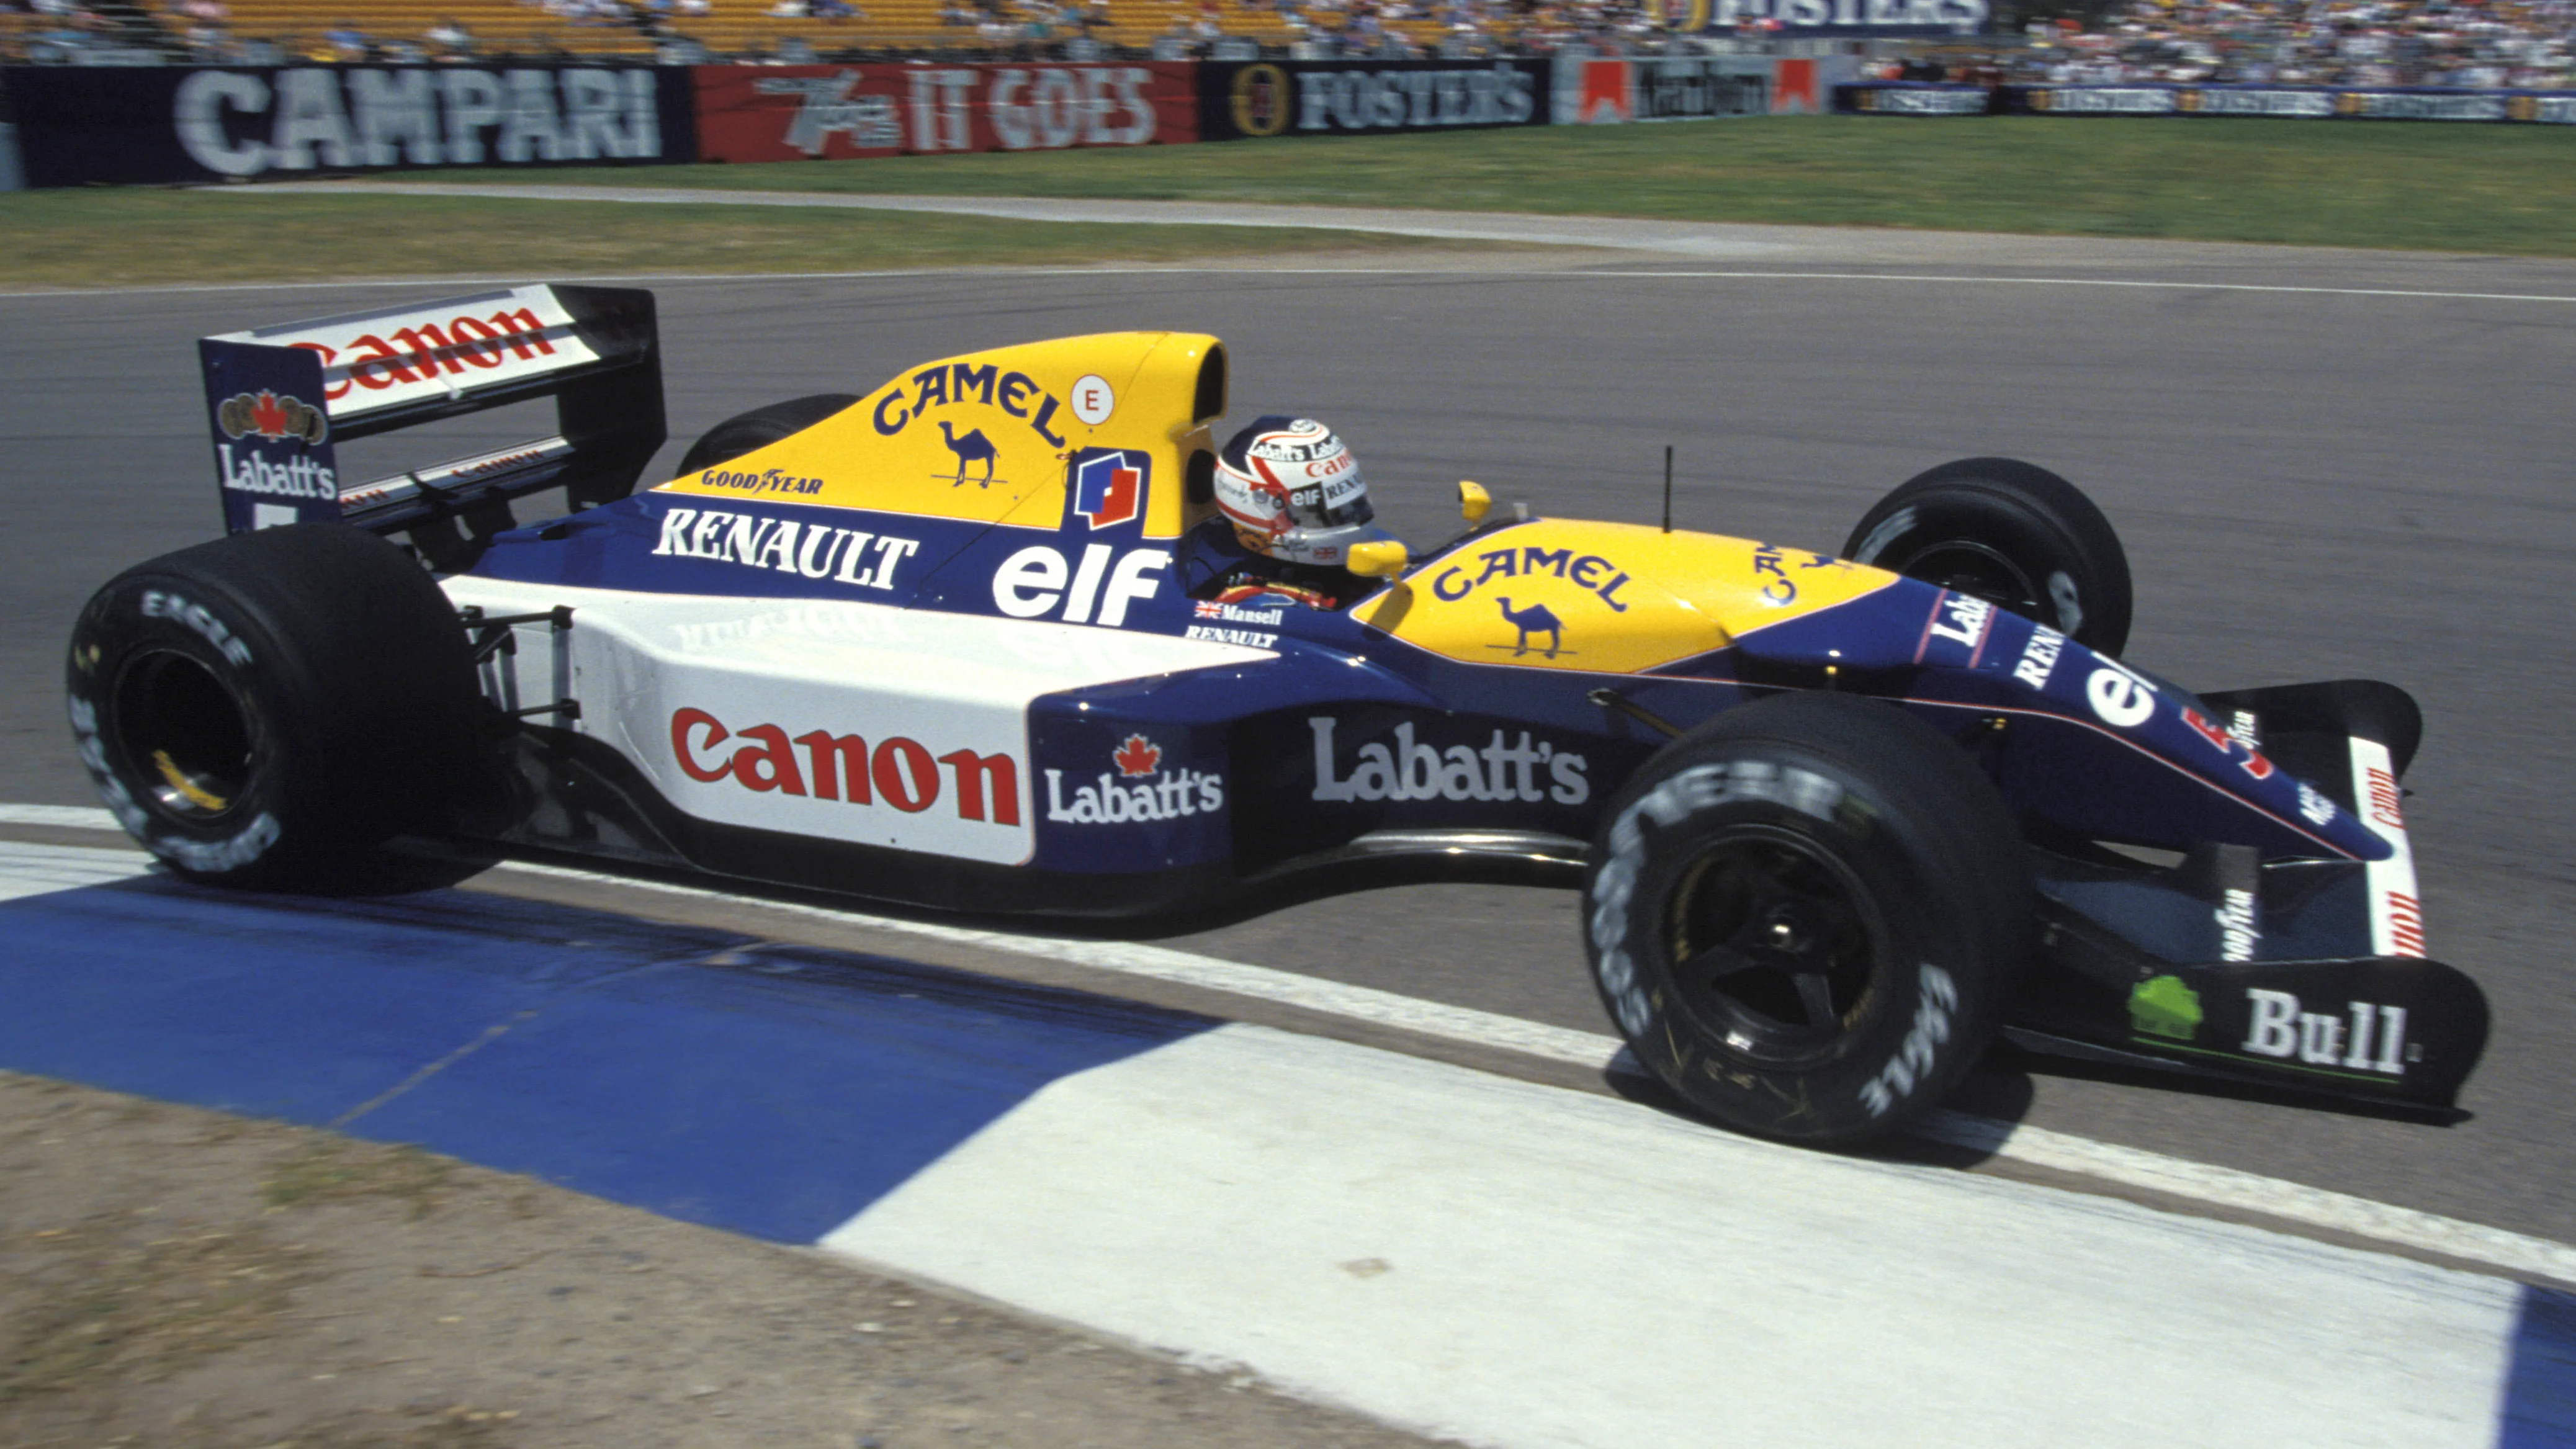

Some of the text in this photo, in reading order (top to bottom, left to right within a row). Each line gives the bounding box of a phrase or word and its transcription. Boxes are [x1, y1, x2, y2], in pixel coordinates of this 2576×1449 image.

[174, 69, 662, 176] CAMPARI
[989, 67, 1158, 150] GOES
[873, 364, 1066, 449] CAMEL
[1085, 389, 1099, 411] E
[218, 443, 337, 500] Labatt's
[1290, 489, 1321, 506] elf
[652, 508, 920, 591] RENAULT
[992, 544, 1169, 627] elf
[1433, 547, 1631, 613] CAMEL
[1185, 625, 1279, 648] RENAULT
[1220, 604, 1283, 626] Mansell
[670, 705, 1021, 825] Canon
[1044, 766, 1224, 825] Labatt's
[1309, 717, 1590, 803] Labatt's
[2242, 987, 2408, 1075] Bull
